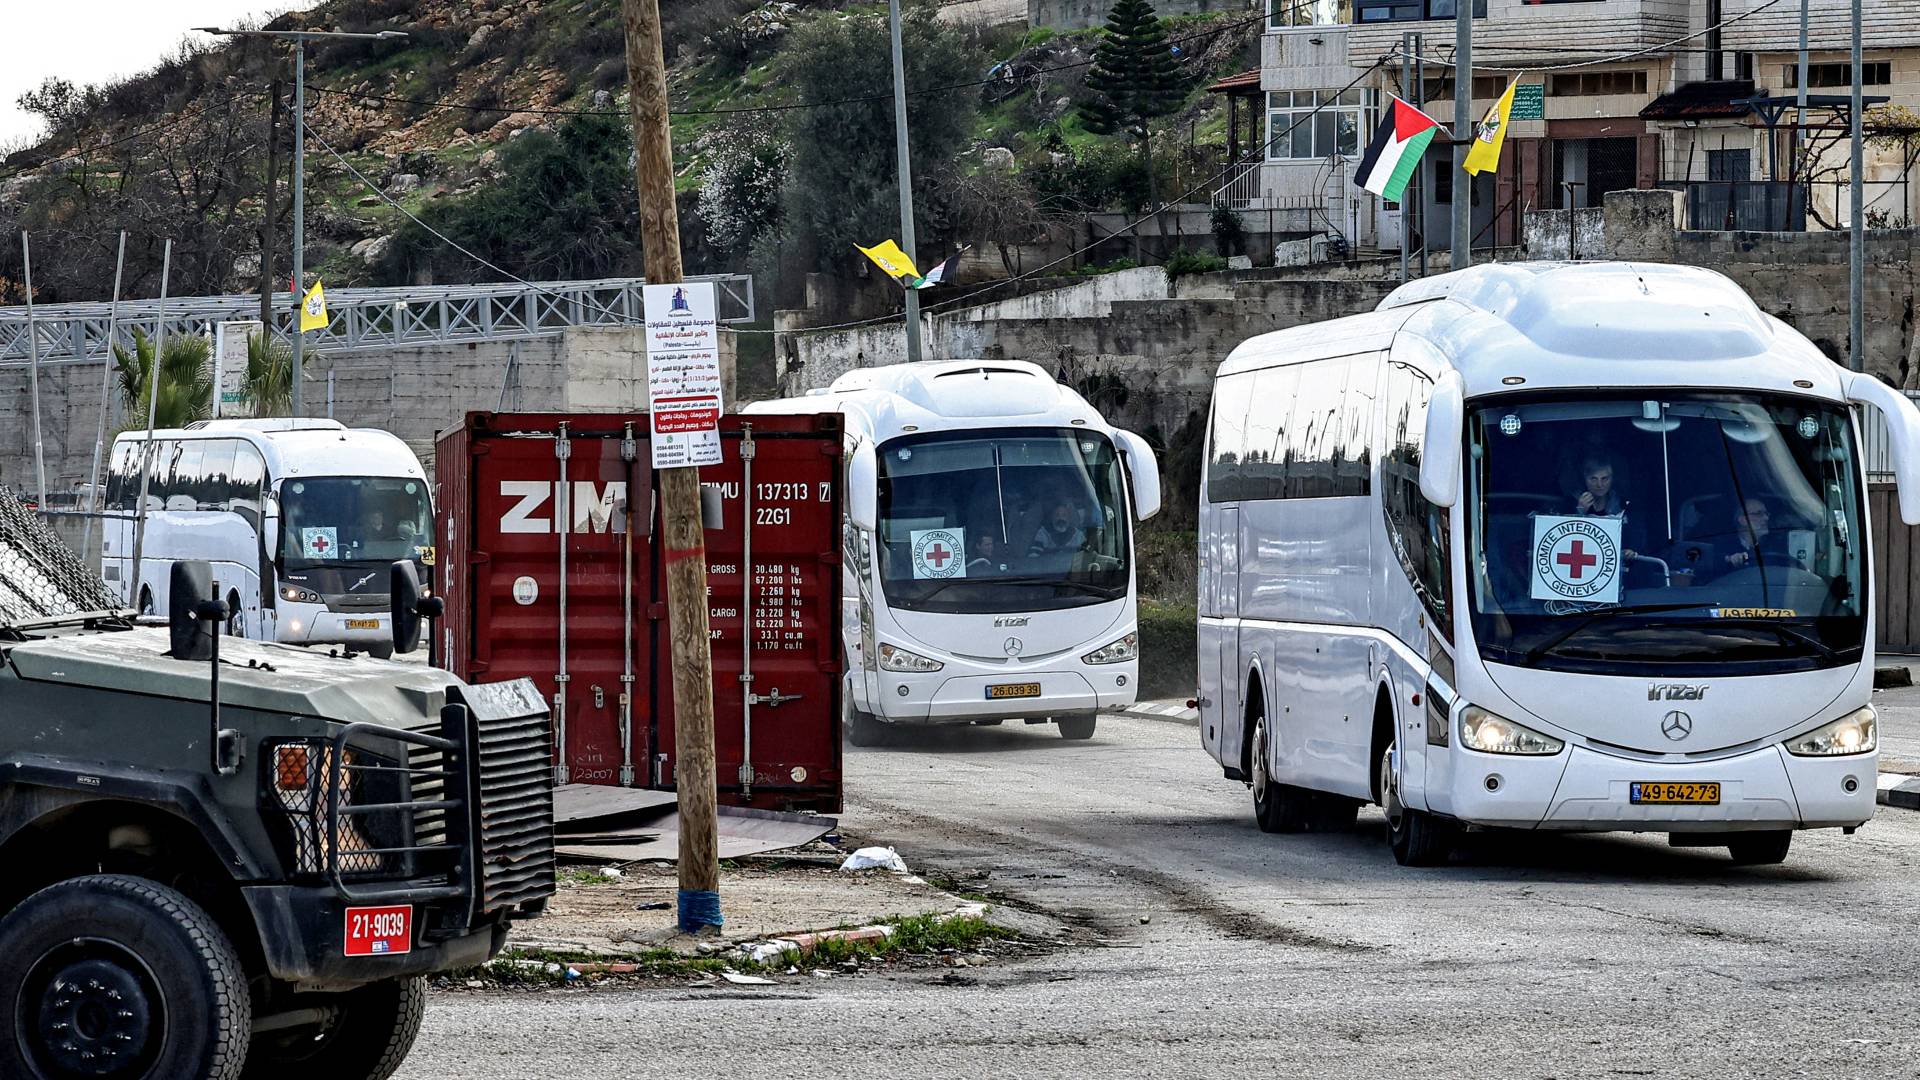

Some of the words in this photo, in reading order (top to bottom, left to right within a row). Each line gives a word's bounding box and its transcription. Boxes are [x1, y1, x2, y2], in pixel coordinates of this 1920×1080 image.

[647, 321, 672, 330] للمقاولات
[672, 320, 692, 328] فلسطين
[693, 320, 714, 328] مجموعة
[756, 483, 808, 500] 137313
[500, 480, 627, 534] ZIM
[756, 508, 790, 525] 22G1
[926, 532, 952, 543] COMITE
[1538, 532, 1558, 574] COMITE
[1557, 522, 1614, 578] INTERNATIONAL
[929, 542, 962, 578] INTERNATIONAL
[711, 564, 736, 574] GROSS
[755, 564, 784, 574] 30.480
[790, 564, 800, 576] kg
[755, 576, 784, 584] 67.200
[791, 576, 802, 584] lbs
[760, 586, 784, 596] 2.260
[791, 586, 800, 598] kg
[1552, 580, 1599, 596] GENEVE
[760, 598, 784, 606] 4.980
[791, 598, 802, 606] lbs
[711, 608, 736, 618] CARGO
[756, 608, 784, 618] 28.220
[791, 608, 800, 620] kg
[756, 620, 784, 628] 62.220
[791, 620, 802, 628] lbs
[761, 630, 779, 640] 33.1
[784, 631, 803, 640] cu.m
[756, 642, 779, 650] 1.170
[1642, 785, 1718, 800] 49-642-73
[352, 912, 404, 938] 21-9039
